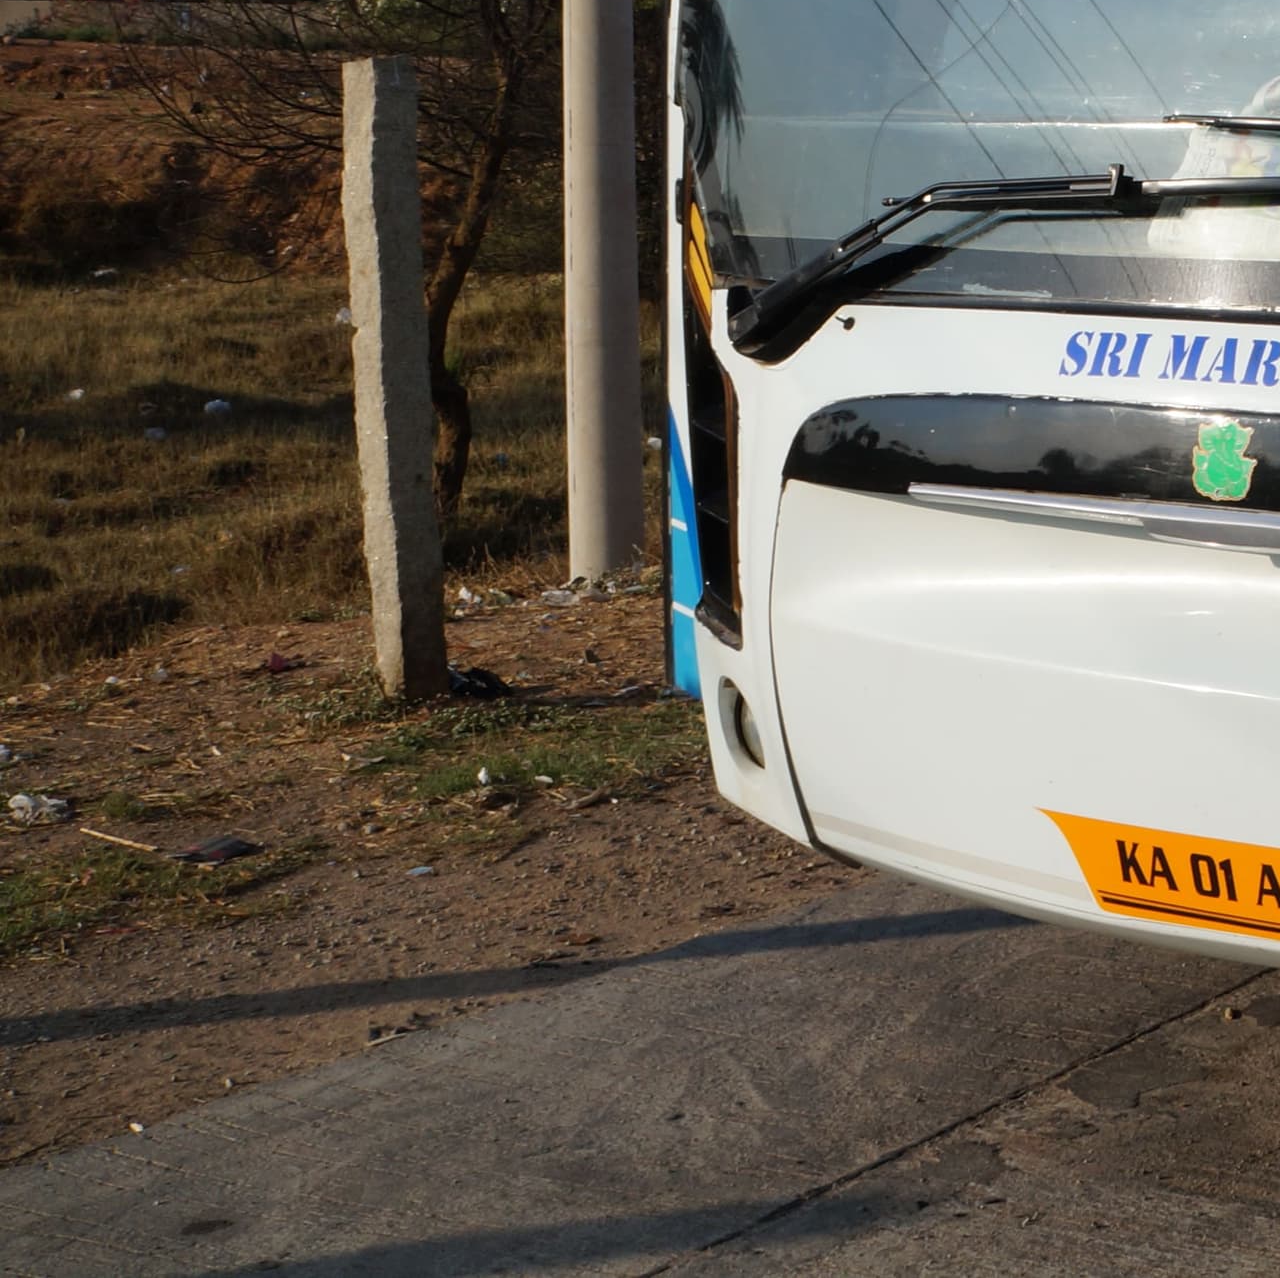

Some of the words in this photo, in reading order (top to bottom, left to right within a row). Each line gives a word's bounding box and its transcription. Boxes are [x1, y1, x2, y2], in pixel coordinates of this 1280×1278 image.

[1058, 330, 1152, 378] SRI
[1115, 839, 1180, 891] KA
[1190, 852, 1238, 902] 01
